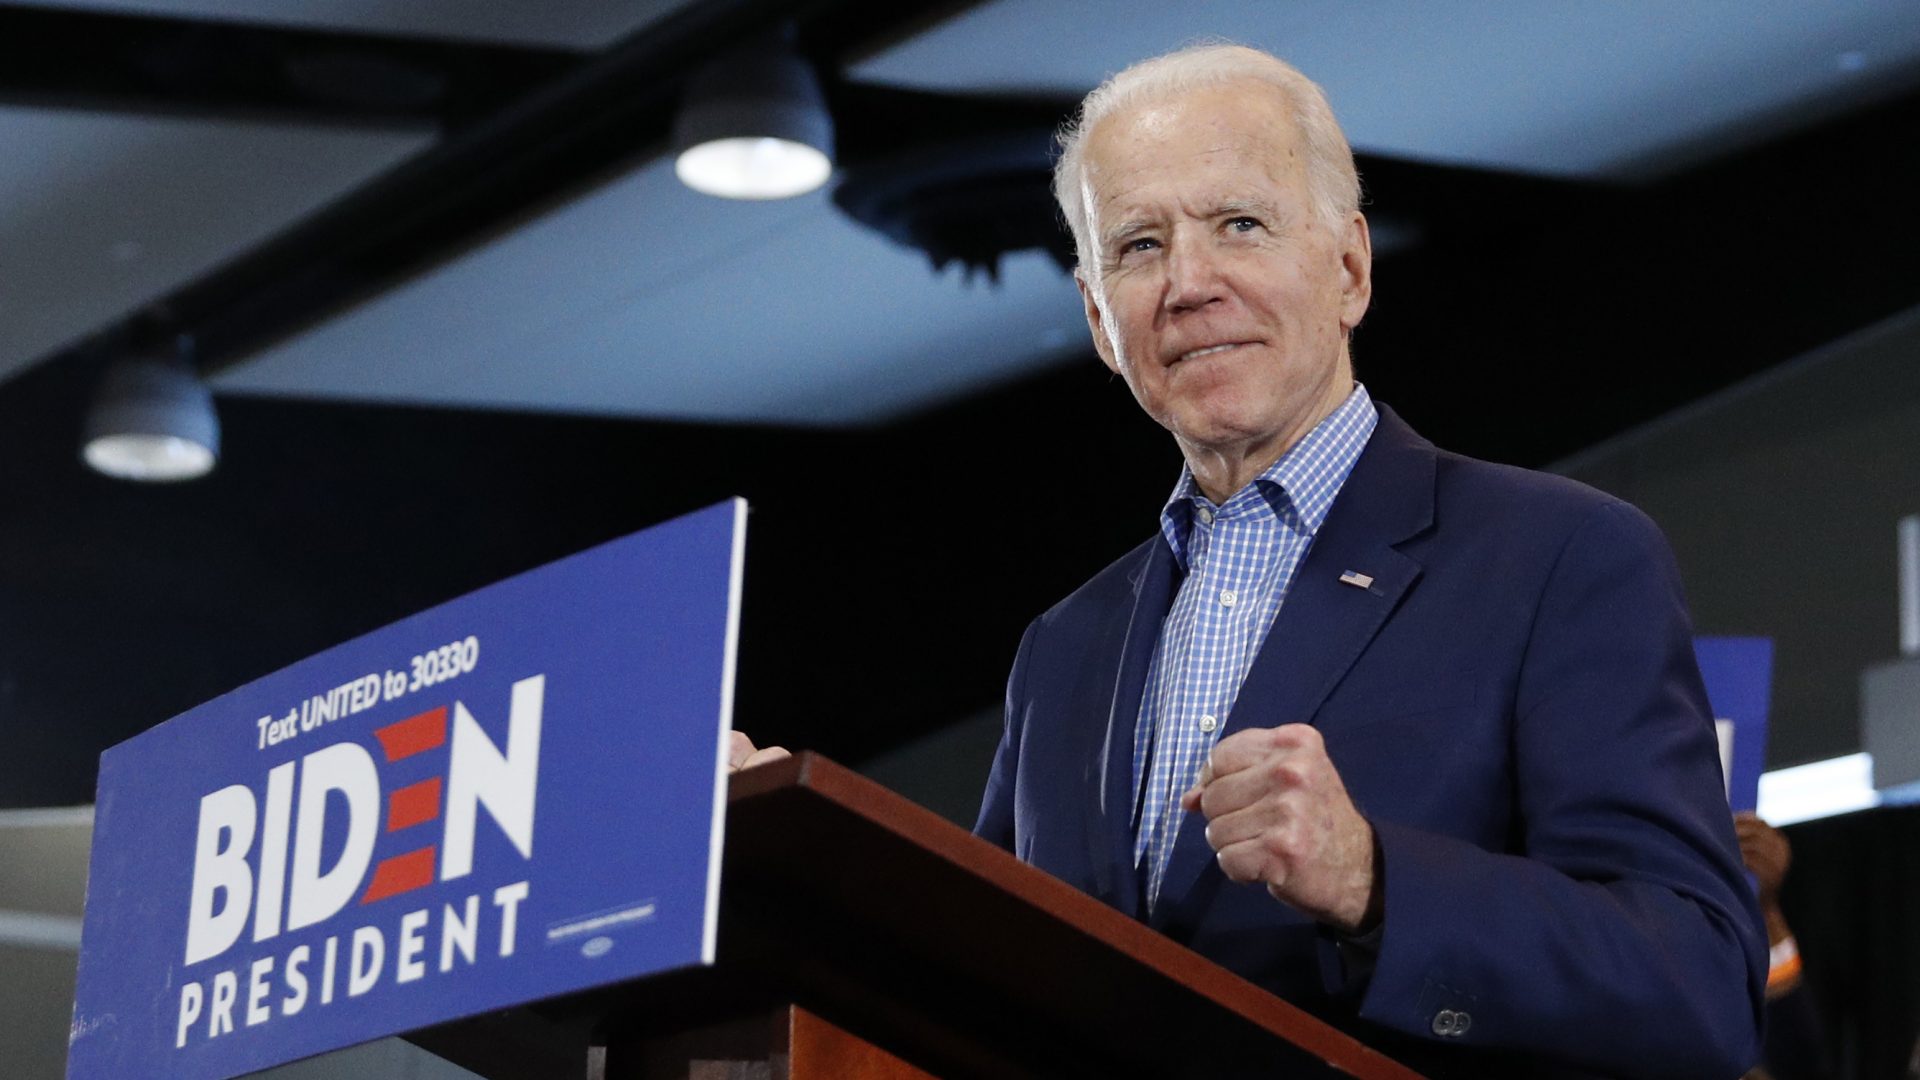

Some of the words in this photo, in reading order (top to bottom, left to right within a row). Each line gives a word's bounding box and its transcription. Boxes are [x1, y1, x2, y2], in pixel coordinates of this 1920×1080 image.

[257, 707, 299, 750] Text
[301, 673, 382, 732] UNITED
[383, 669, 408, 701] to
[409, 635, 479, 693] 30330
[184, 674, 545, 967] BIDEN
[176, 880, 529, 1049] PRESIDENT
